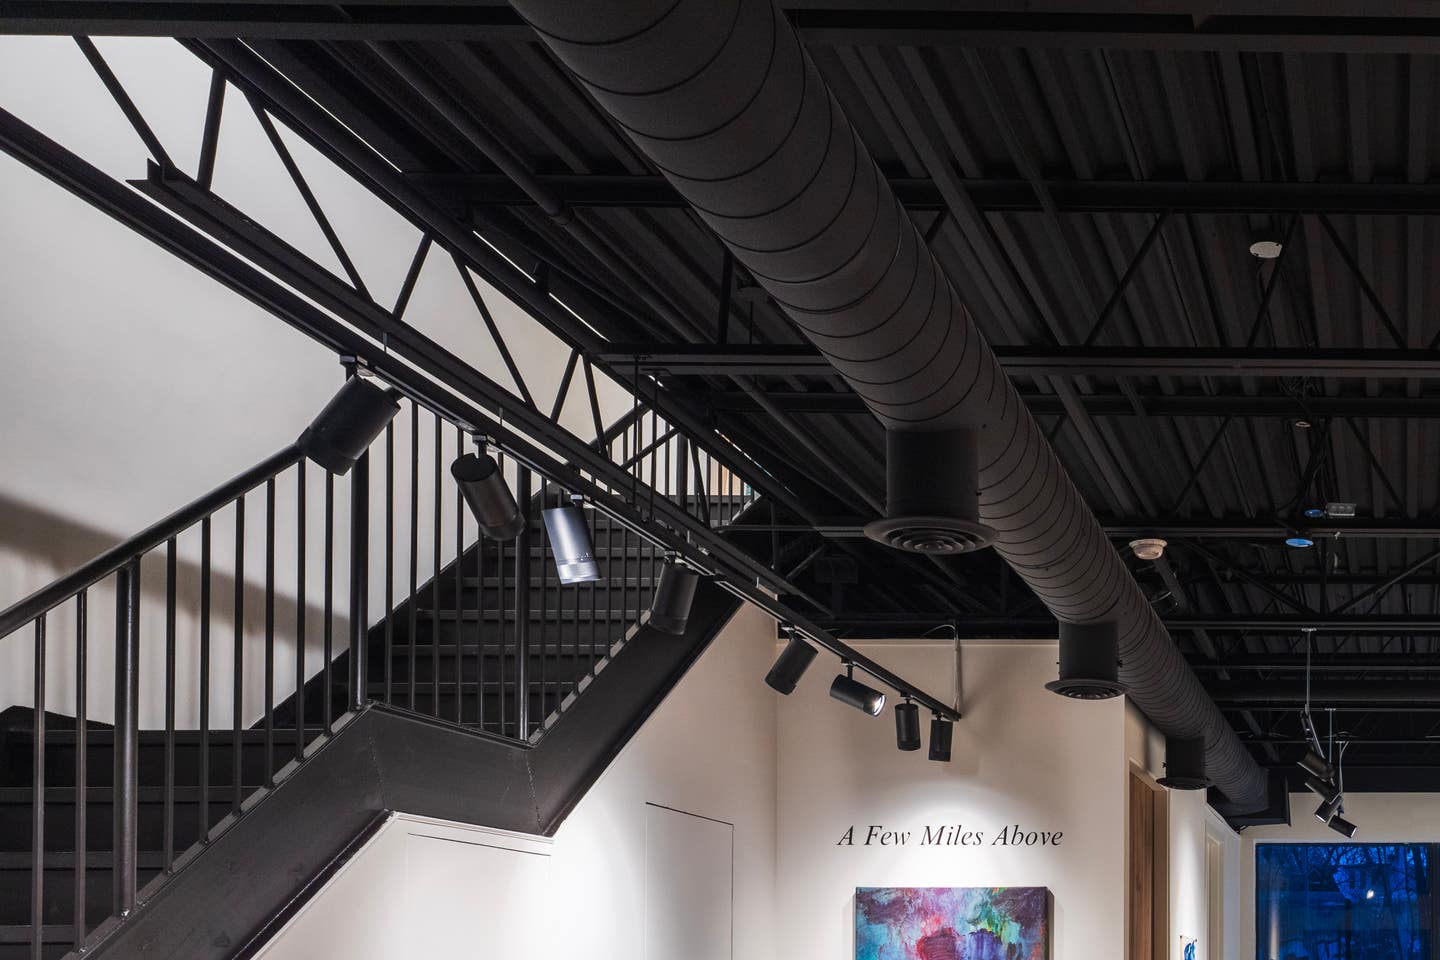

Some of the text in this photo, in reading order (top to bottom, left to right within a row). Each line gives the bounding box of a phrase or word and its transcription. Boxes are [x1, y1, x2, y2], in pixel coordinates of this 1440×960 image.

[837, 825, 1064, 846] A Few Miles Above
